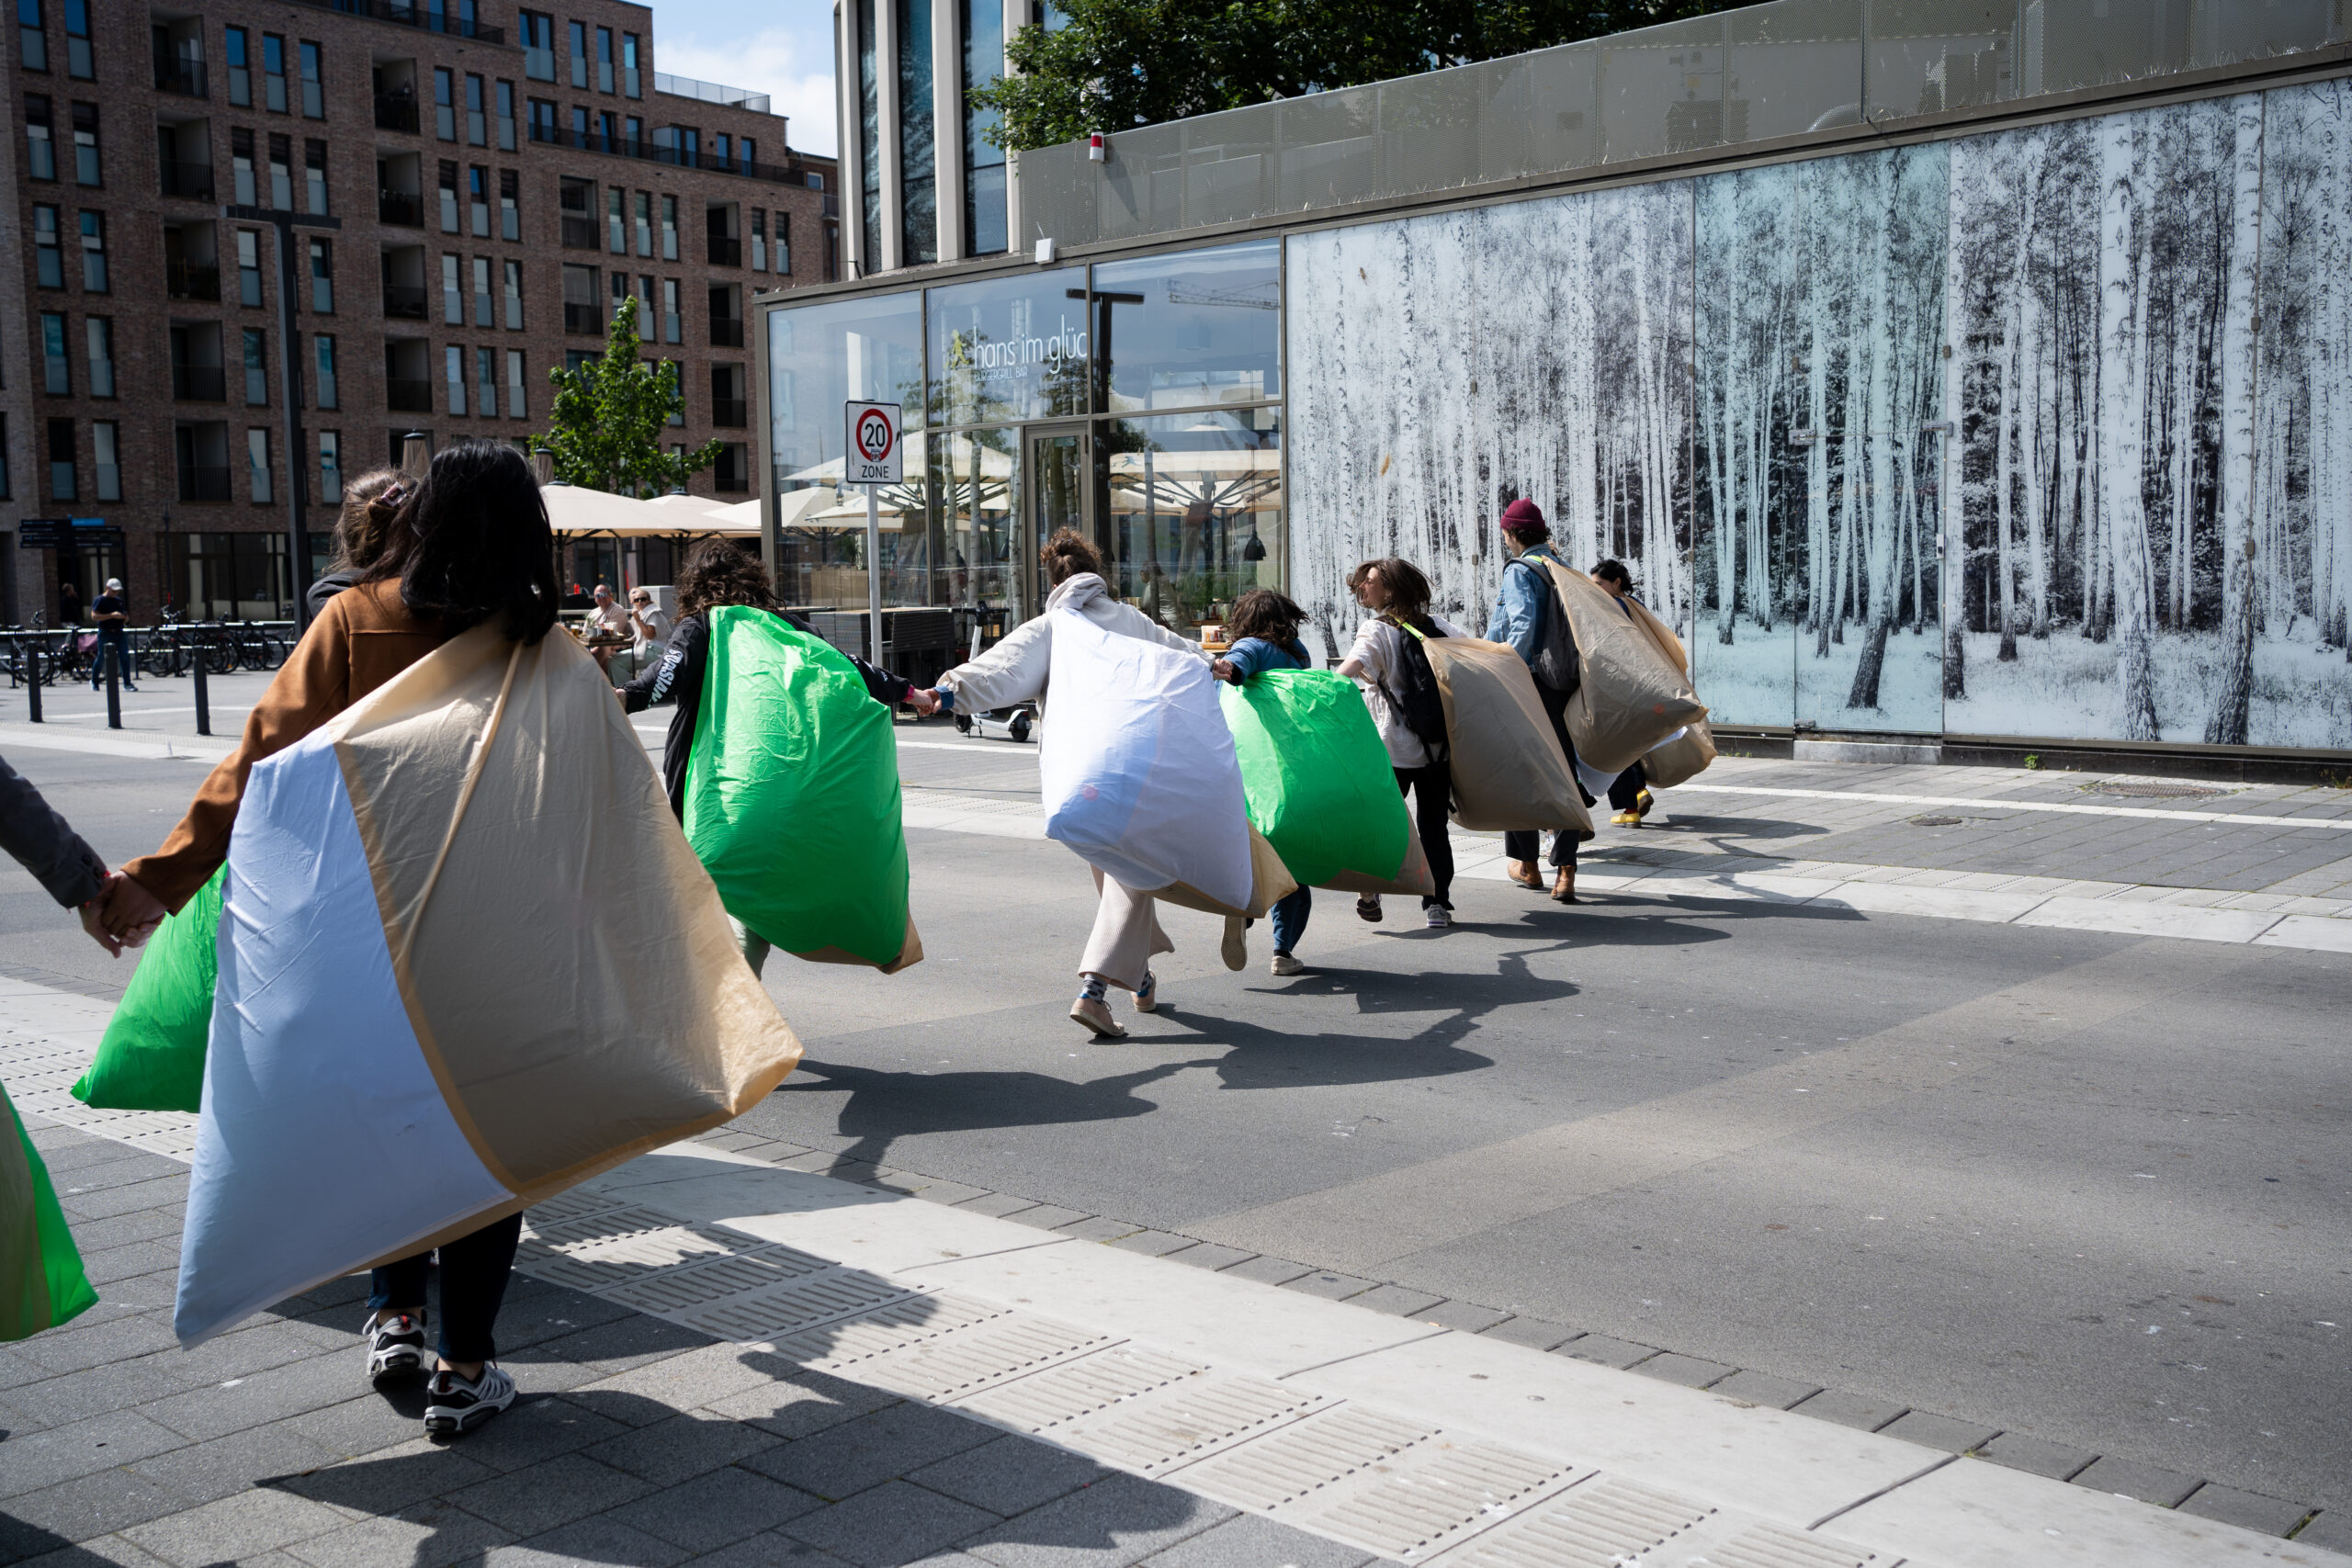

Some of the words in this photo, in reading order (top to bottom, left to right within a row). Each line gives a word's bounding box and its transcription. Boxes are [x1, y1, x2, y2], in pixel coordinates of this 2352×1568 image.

[974, 325, 1015, 369] hans
[1022, 333, 1043, 364] im
[975, 367, 1013, 382] BURGERGRILL
[1015, 366, 1028, 378] BAR
[865, 423, 886, 447] 20
[861, 465, 889, 479] ZONE
